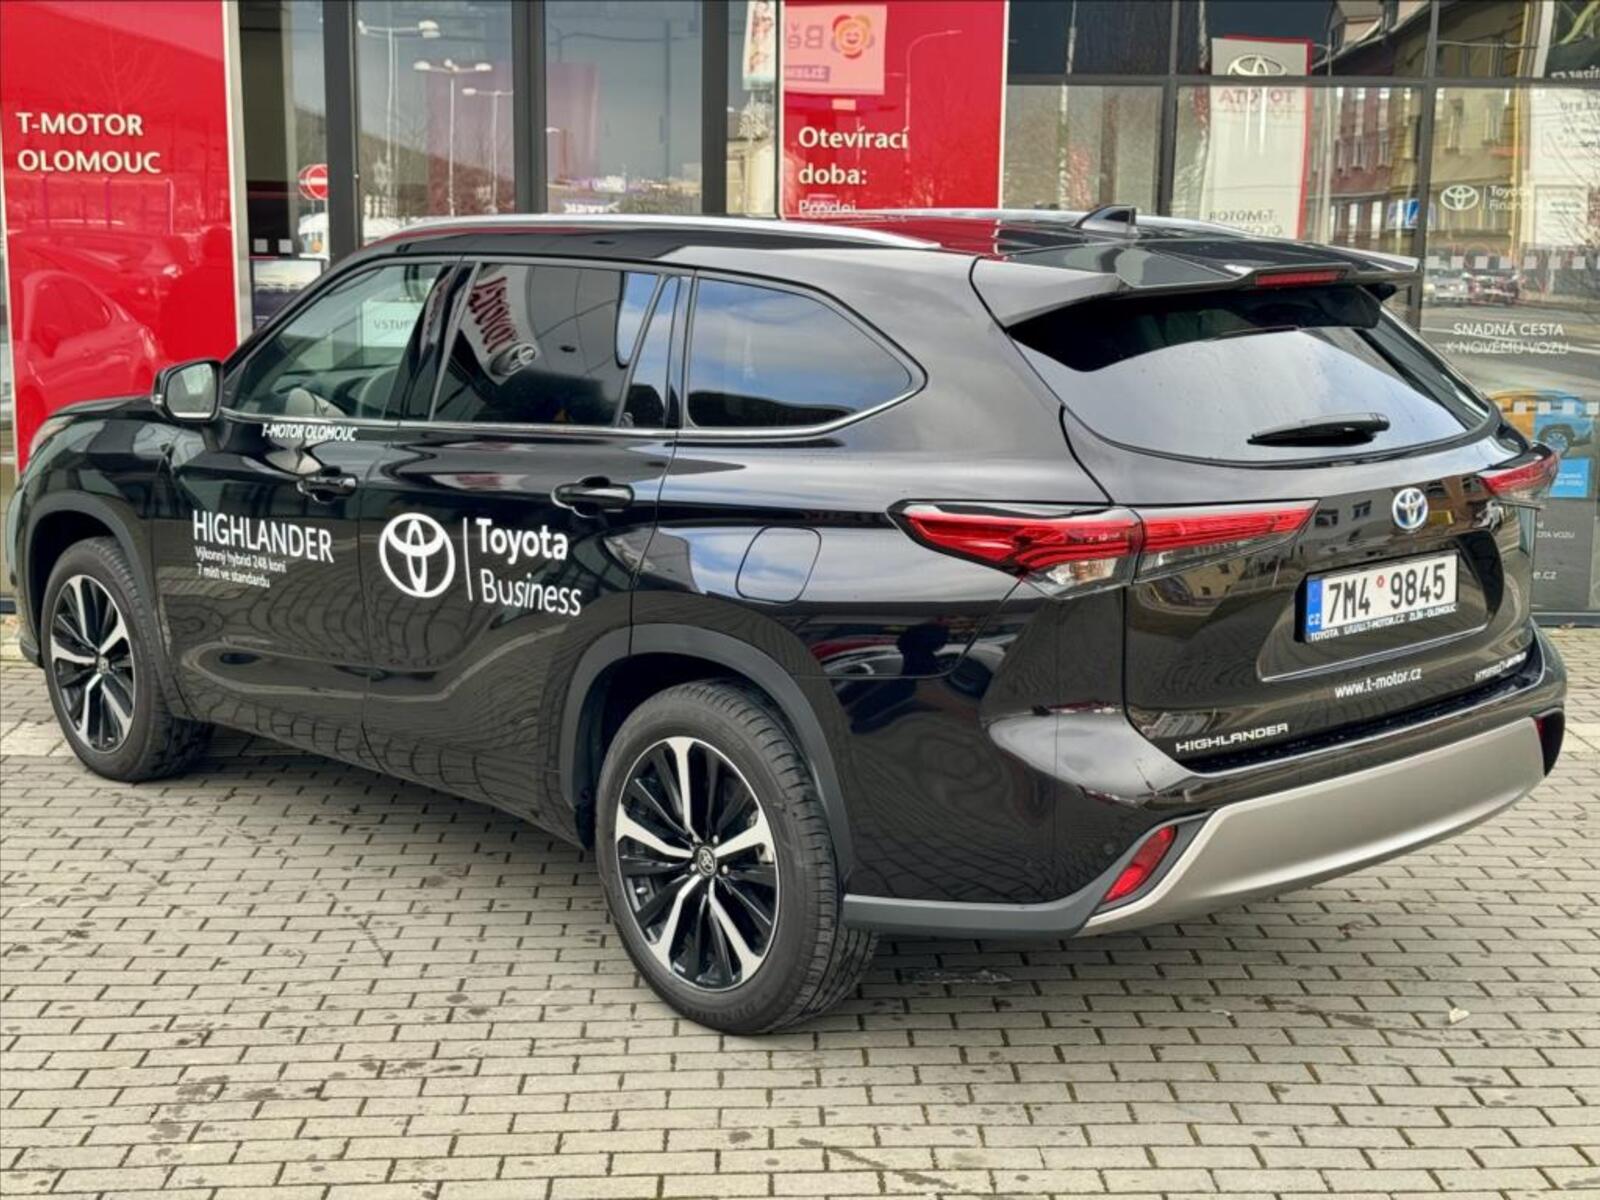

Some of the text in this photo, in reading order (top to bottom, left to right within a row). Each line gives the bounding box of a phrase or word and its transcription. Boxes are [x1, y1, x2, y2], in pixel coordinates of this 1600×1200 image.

[15, 111, 144, 137] T-MOTOR
[798, 125, 910, 149] Otevírací
[17, 149, 161, 174] OLOMOUC
[798, 162, 868, 185] doba:
[1453, 321, 1565, 336] SNADNÁ CESTA
[1459, 337, 1524, 354] NOVÉMU
[1528, 341, 1569, 355] VOZU
[261, 423, 358, 441] T-MOTOR OLOMOUC
[192, 509, 335, 564] HIGHLANDER
[475, 517, 569, 565] Toyota
[480, 568, 582, 617] Business
[1328, 563, 1447, 624] 7M4 9845
[1308, 612, 1321, 626] CZ
[1310, 627, 1340, 642] TOYOTA
[1334, 667, 1423, 699] www.t-motor.cz
[1175, 722, 1289, 753] HIGHLANDER
